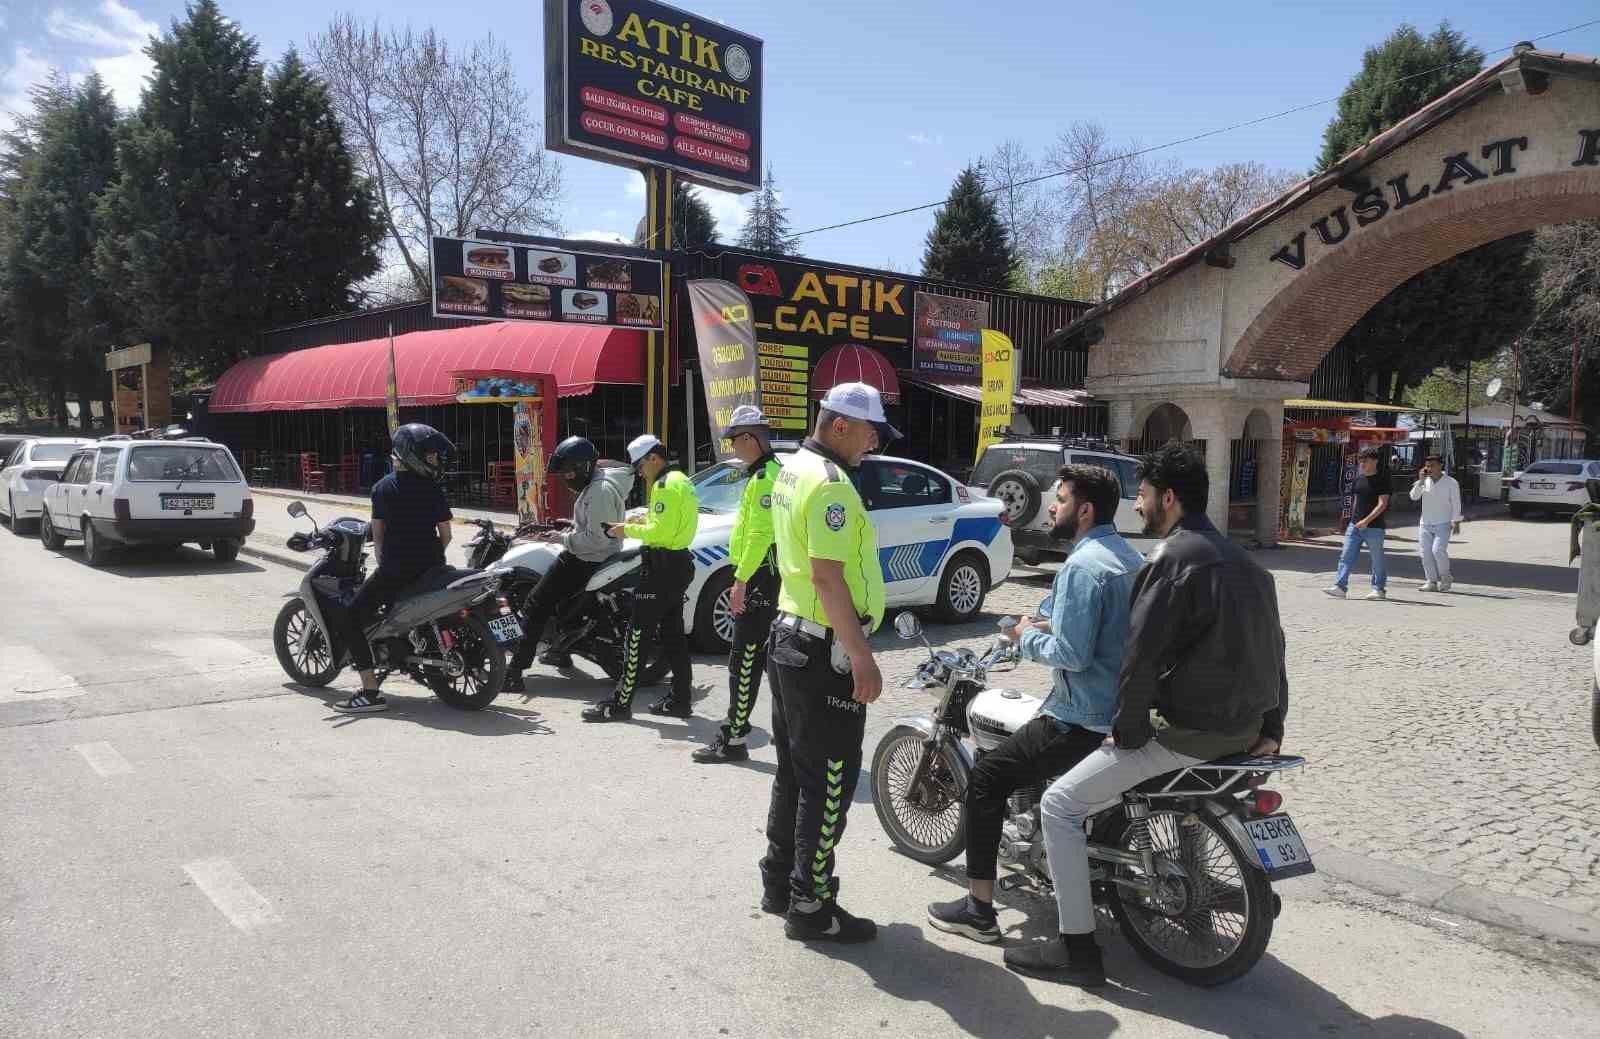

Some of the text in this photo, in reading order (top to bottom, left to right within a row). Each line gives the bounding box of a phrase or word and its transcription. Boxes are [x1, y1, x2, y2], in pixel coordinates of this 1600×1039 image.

[616, 12, 722, 73] ATİK
[579, 37, 751, 104] RESTAURANT
[636, 79, 704, 111] CAFE
[1270, 136, 1528, 270] VUSLAT
[775, 306, 872, 340] CAFE
[1278, 843, 1297, 862] 93
